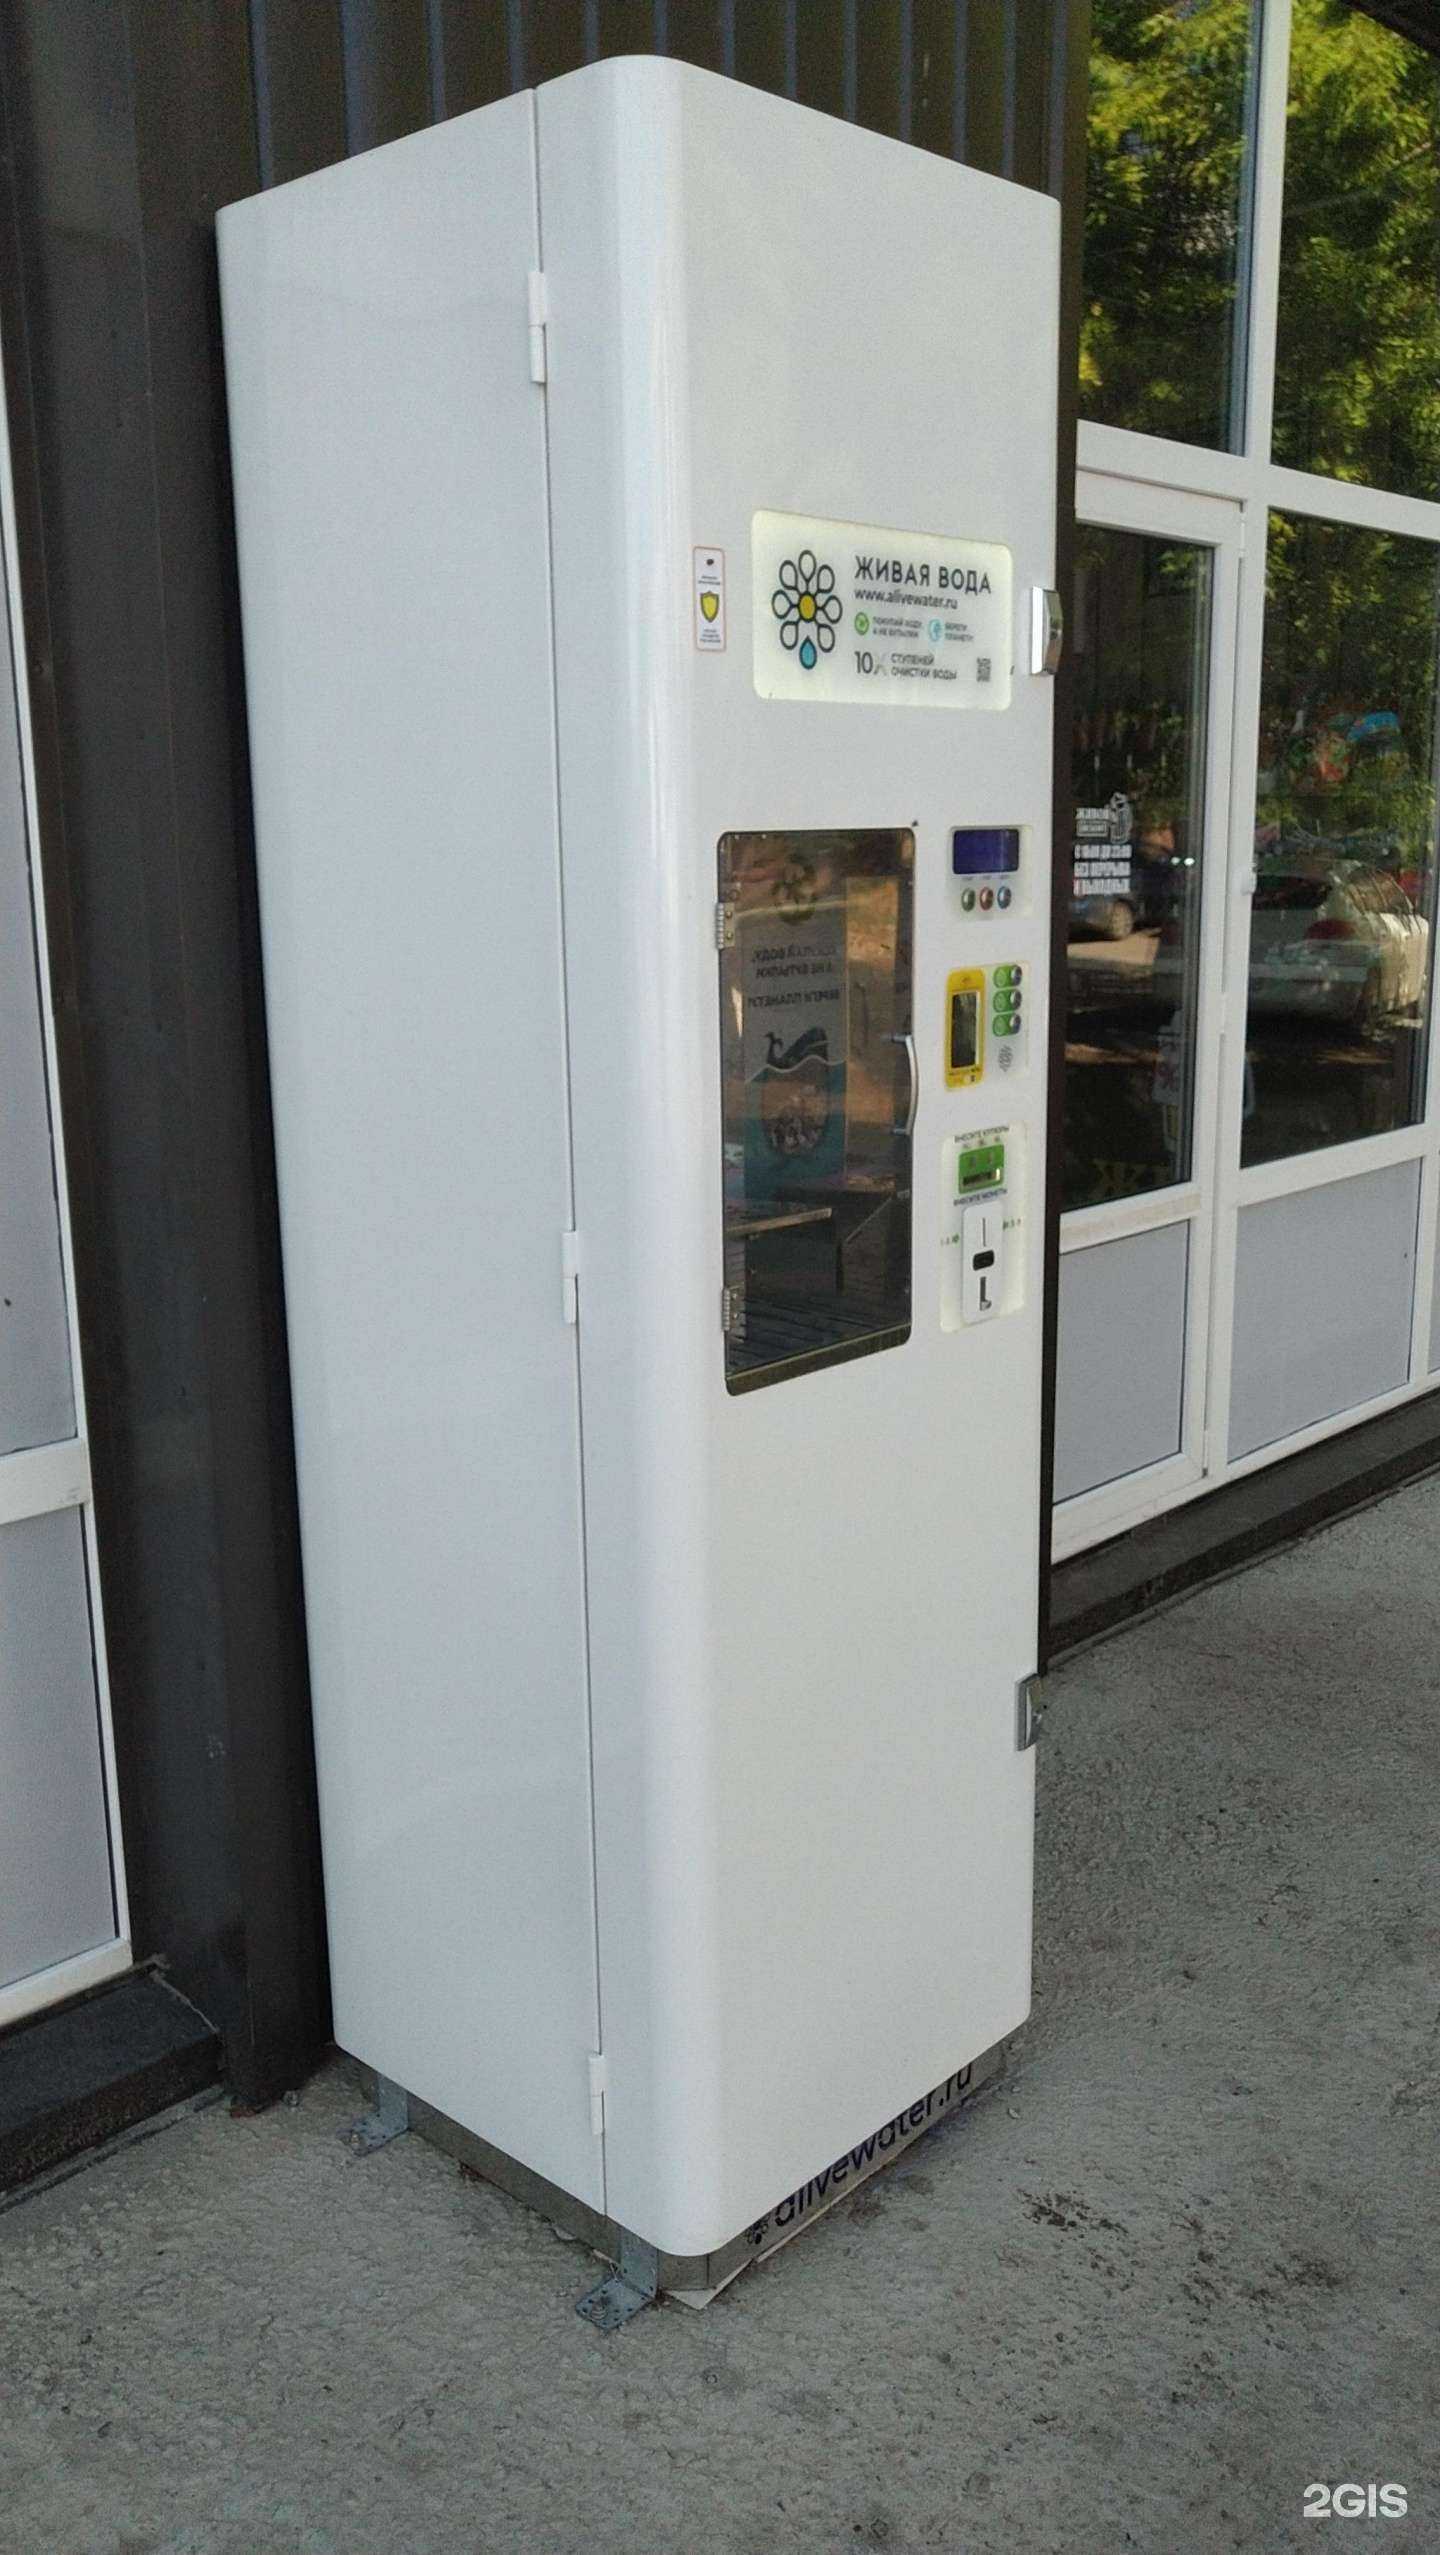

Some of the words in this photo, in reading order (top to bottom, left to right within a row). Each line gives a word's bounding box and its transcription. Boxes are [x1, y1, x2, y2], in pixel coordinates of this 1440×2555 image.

[854, 555, 930, 588] ЖИВАЯ
[938, 565, 992, 596] ВОДА
[854, 587, 959, 610] www.alivewater.ru
[854, 650, 874, 674] 10
[775, 2062, 972, 2228] alivewater.ru
